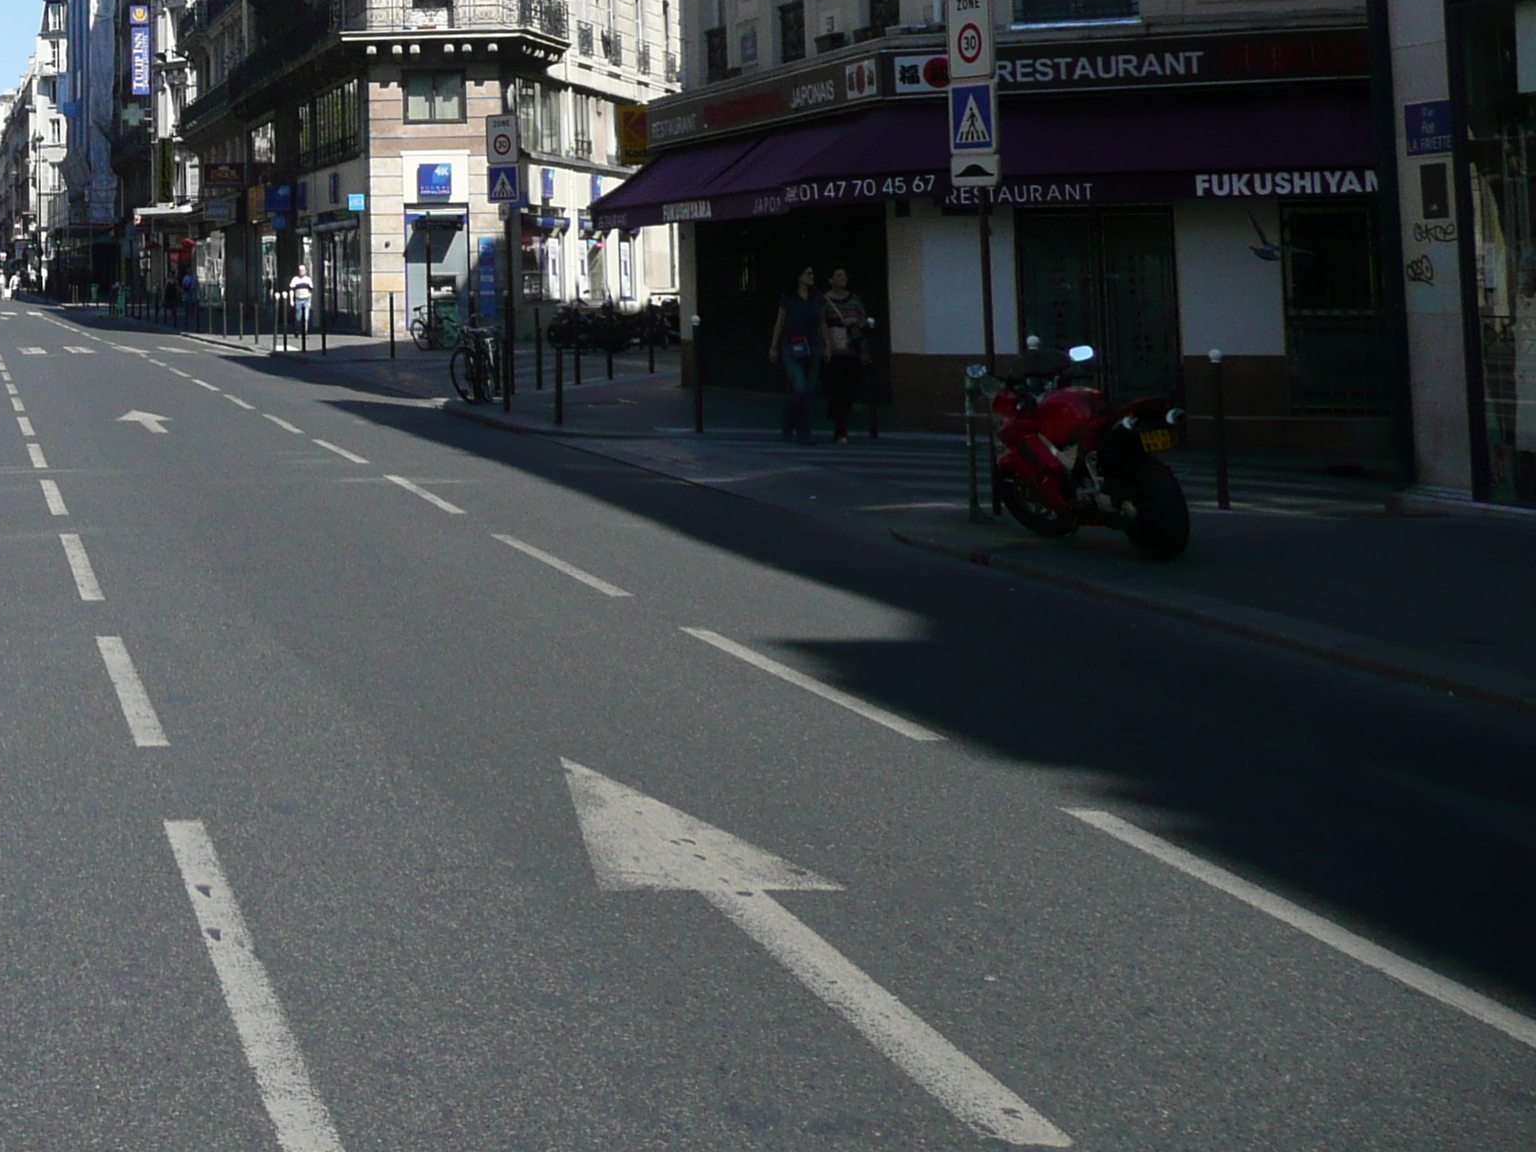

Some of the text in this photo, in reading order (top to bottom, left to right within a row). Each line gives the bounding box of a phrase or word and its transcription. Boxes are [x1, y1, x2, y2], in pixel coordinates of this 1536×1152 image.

[963, 35, 977, 51] 30
[133, 55, 145, 89] TULIP
[994, 51, 1204, 82] RESTAURANT
[790, 79, 835, 108] JAPONAIS
[799, 183, 819, 201] 01
[824, 181, 847, 198] 47
[852, 179, 876, 197] 70
[882, 176, 906, 194] 45
[912, 174, 936, 193] 67
